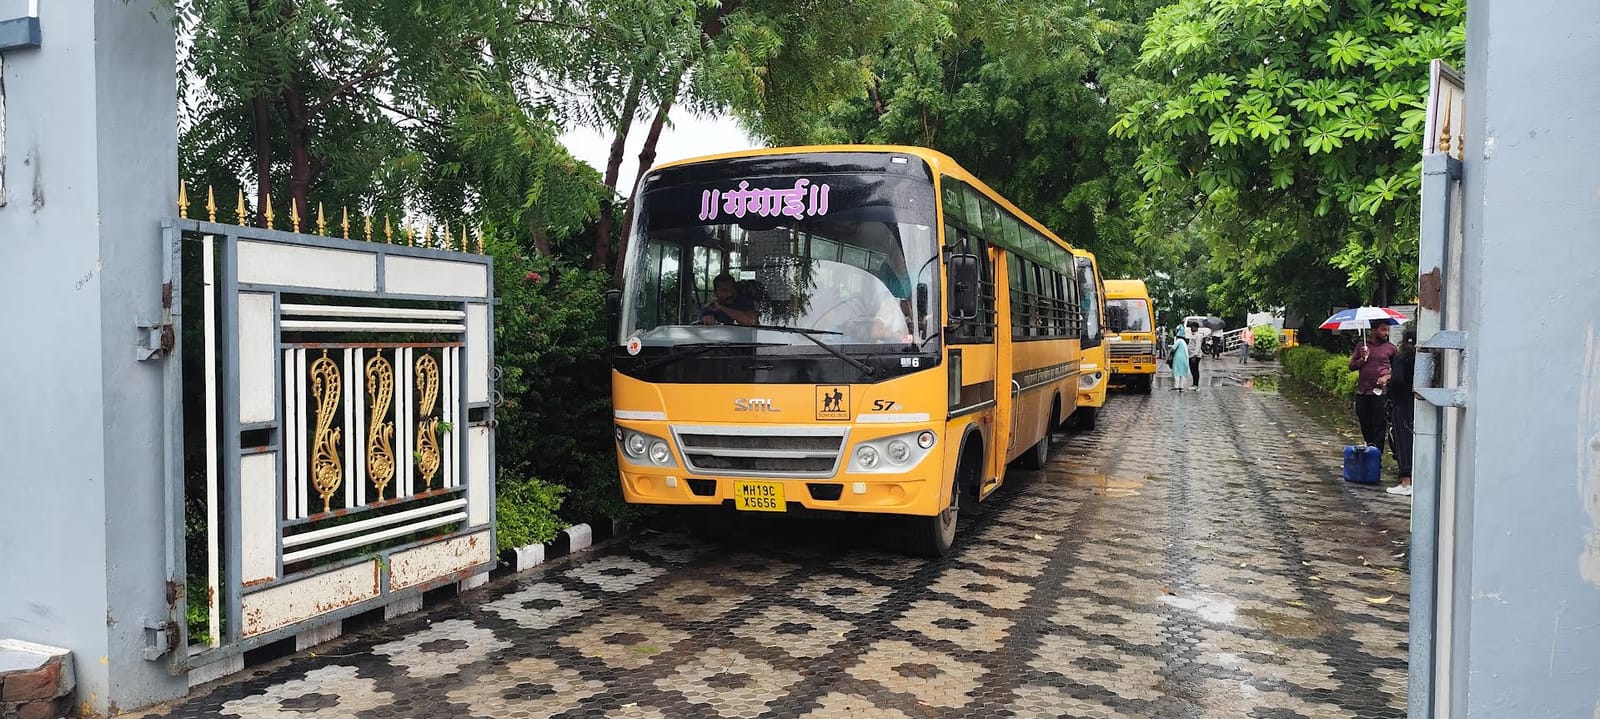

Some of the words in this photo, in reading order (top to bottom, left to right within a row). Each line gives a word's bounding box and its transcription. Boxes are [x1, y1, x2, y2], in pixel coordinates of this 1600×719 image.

[734, 398, 781, 412] SML
[743, 484, 776, 497] MH19C
[744, 496, 777, 509] X5656
